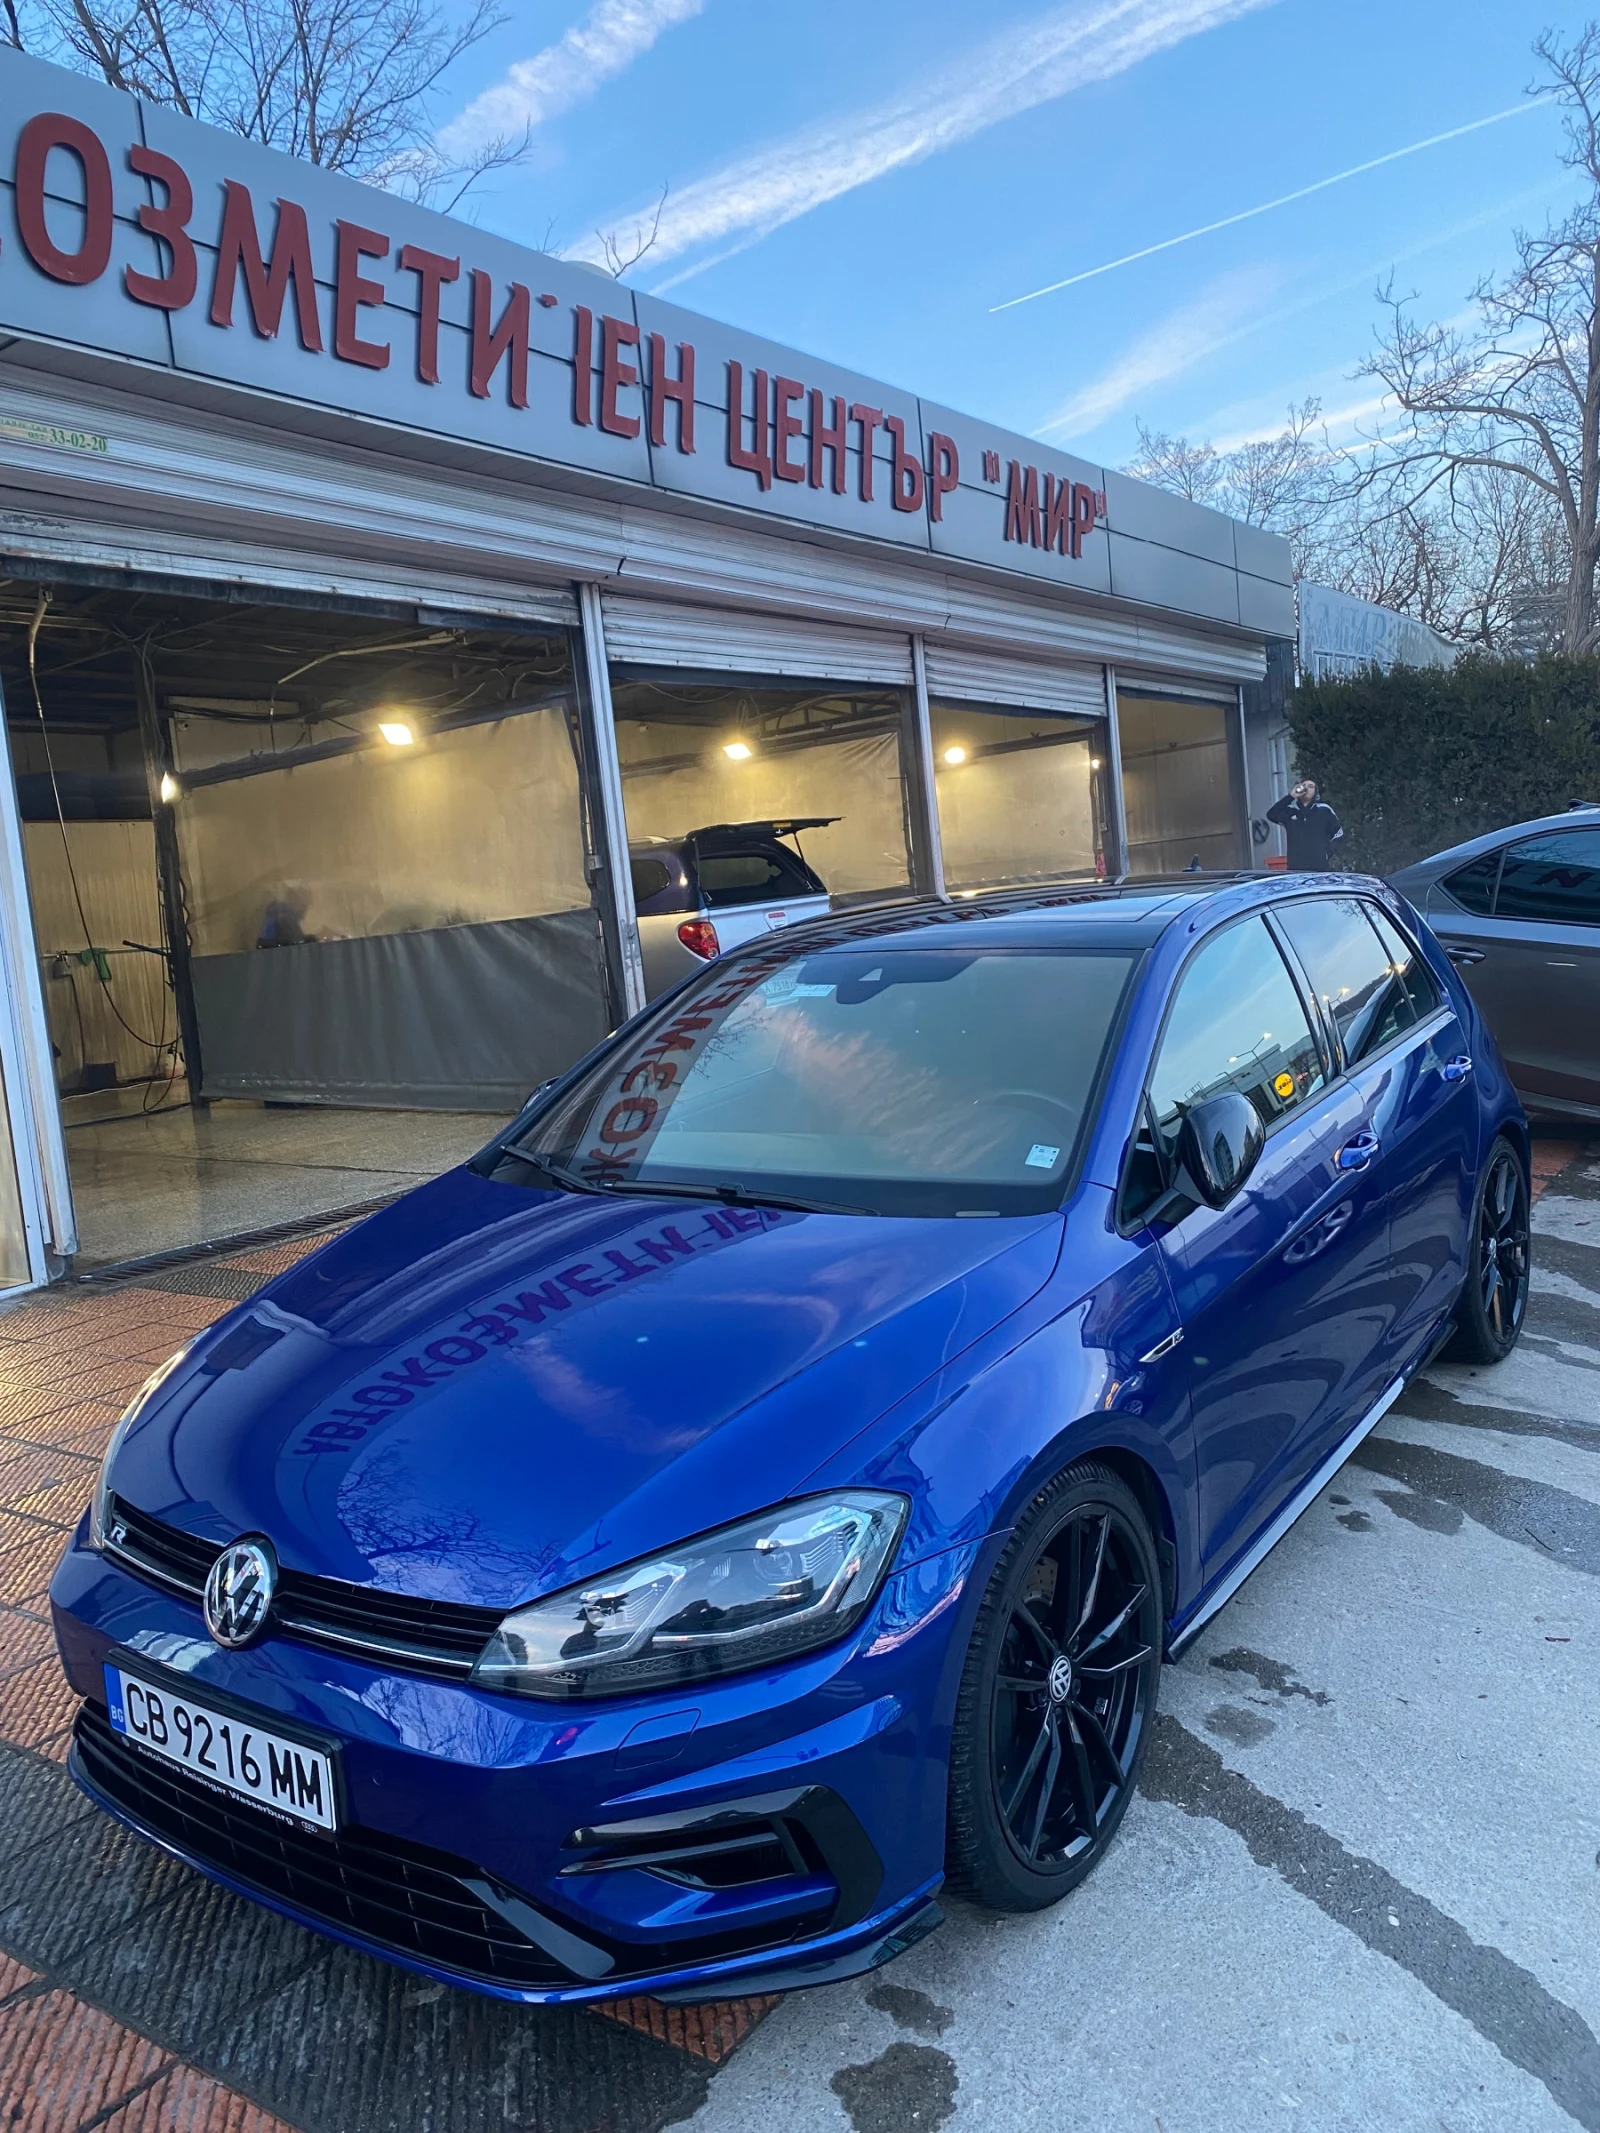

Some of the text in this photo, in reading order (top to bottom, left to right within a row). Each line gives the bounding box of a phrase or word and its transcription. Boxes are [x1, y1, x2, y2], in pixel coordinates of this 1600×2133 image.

[0, 112, 696, 455] ОЗМЕТИЧЕН
[728, 360, 959, 522] ЦЕНТЪР
[49, 428, 108, 453] 33-02-20
[110, 1703, 125, 1724] BG
[137, 1745, 182, 1773] Autohaus
[229, 1789, 294, 1827] Wasserburg
